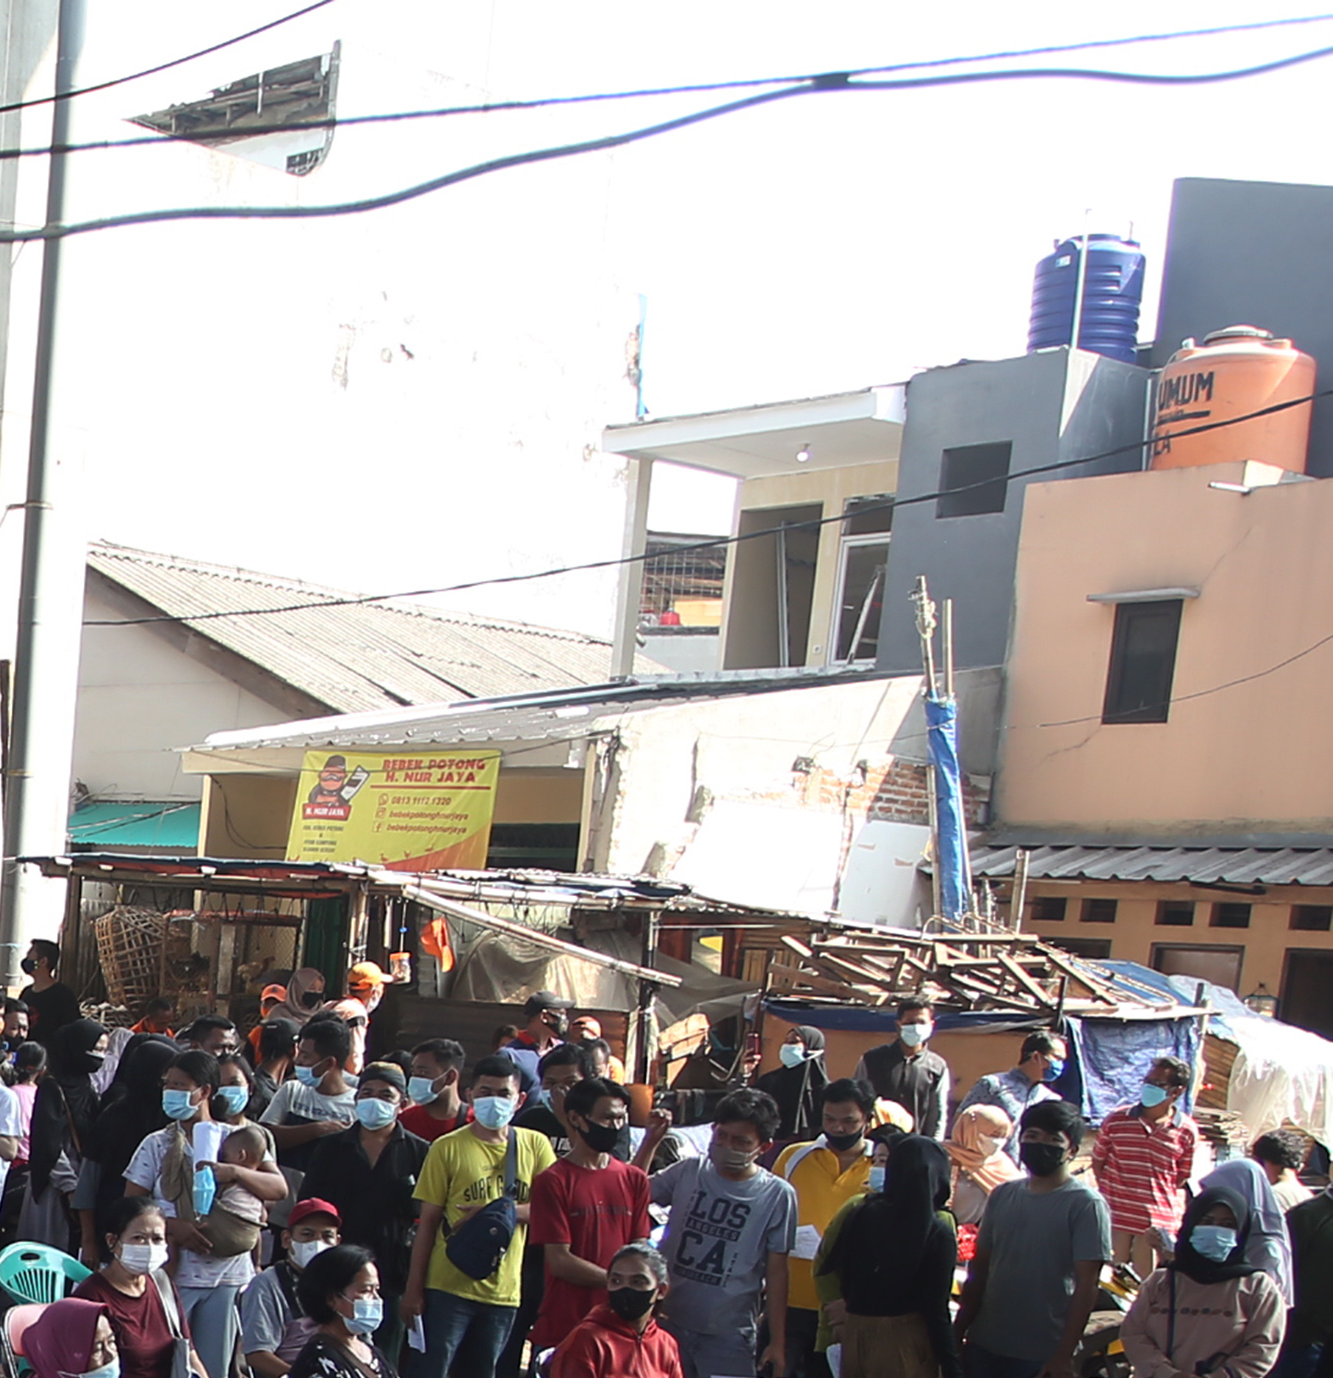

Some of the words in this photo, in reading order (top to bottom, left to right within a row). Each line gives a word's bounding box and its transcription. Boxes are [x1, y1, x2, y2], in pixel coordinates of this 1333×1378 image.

[383, 759, 424, 770] BEBEK
[428, 759, 485, 770] POTONG
[404, 772, 432, 783] NUR
[437, 772, 476, 783] JAYA
[463, 1176, 493, 1202] SURF
[689, 1190, 751, 1229] LOS
[687, 1218, 739, 1241] ANGELES
[676, 1230, 725, 1275] CA
